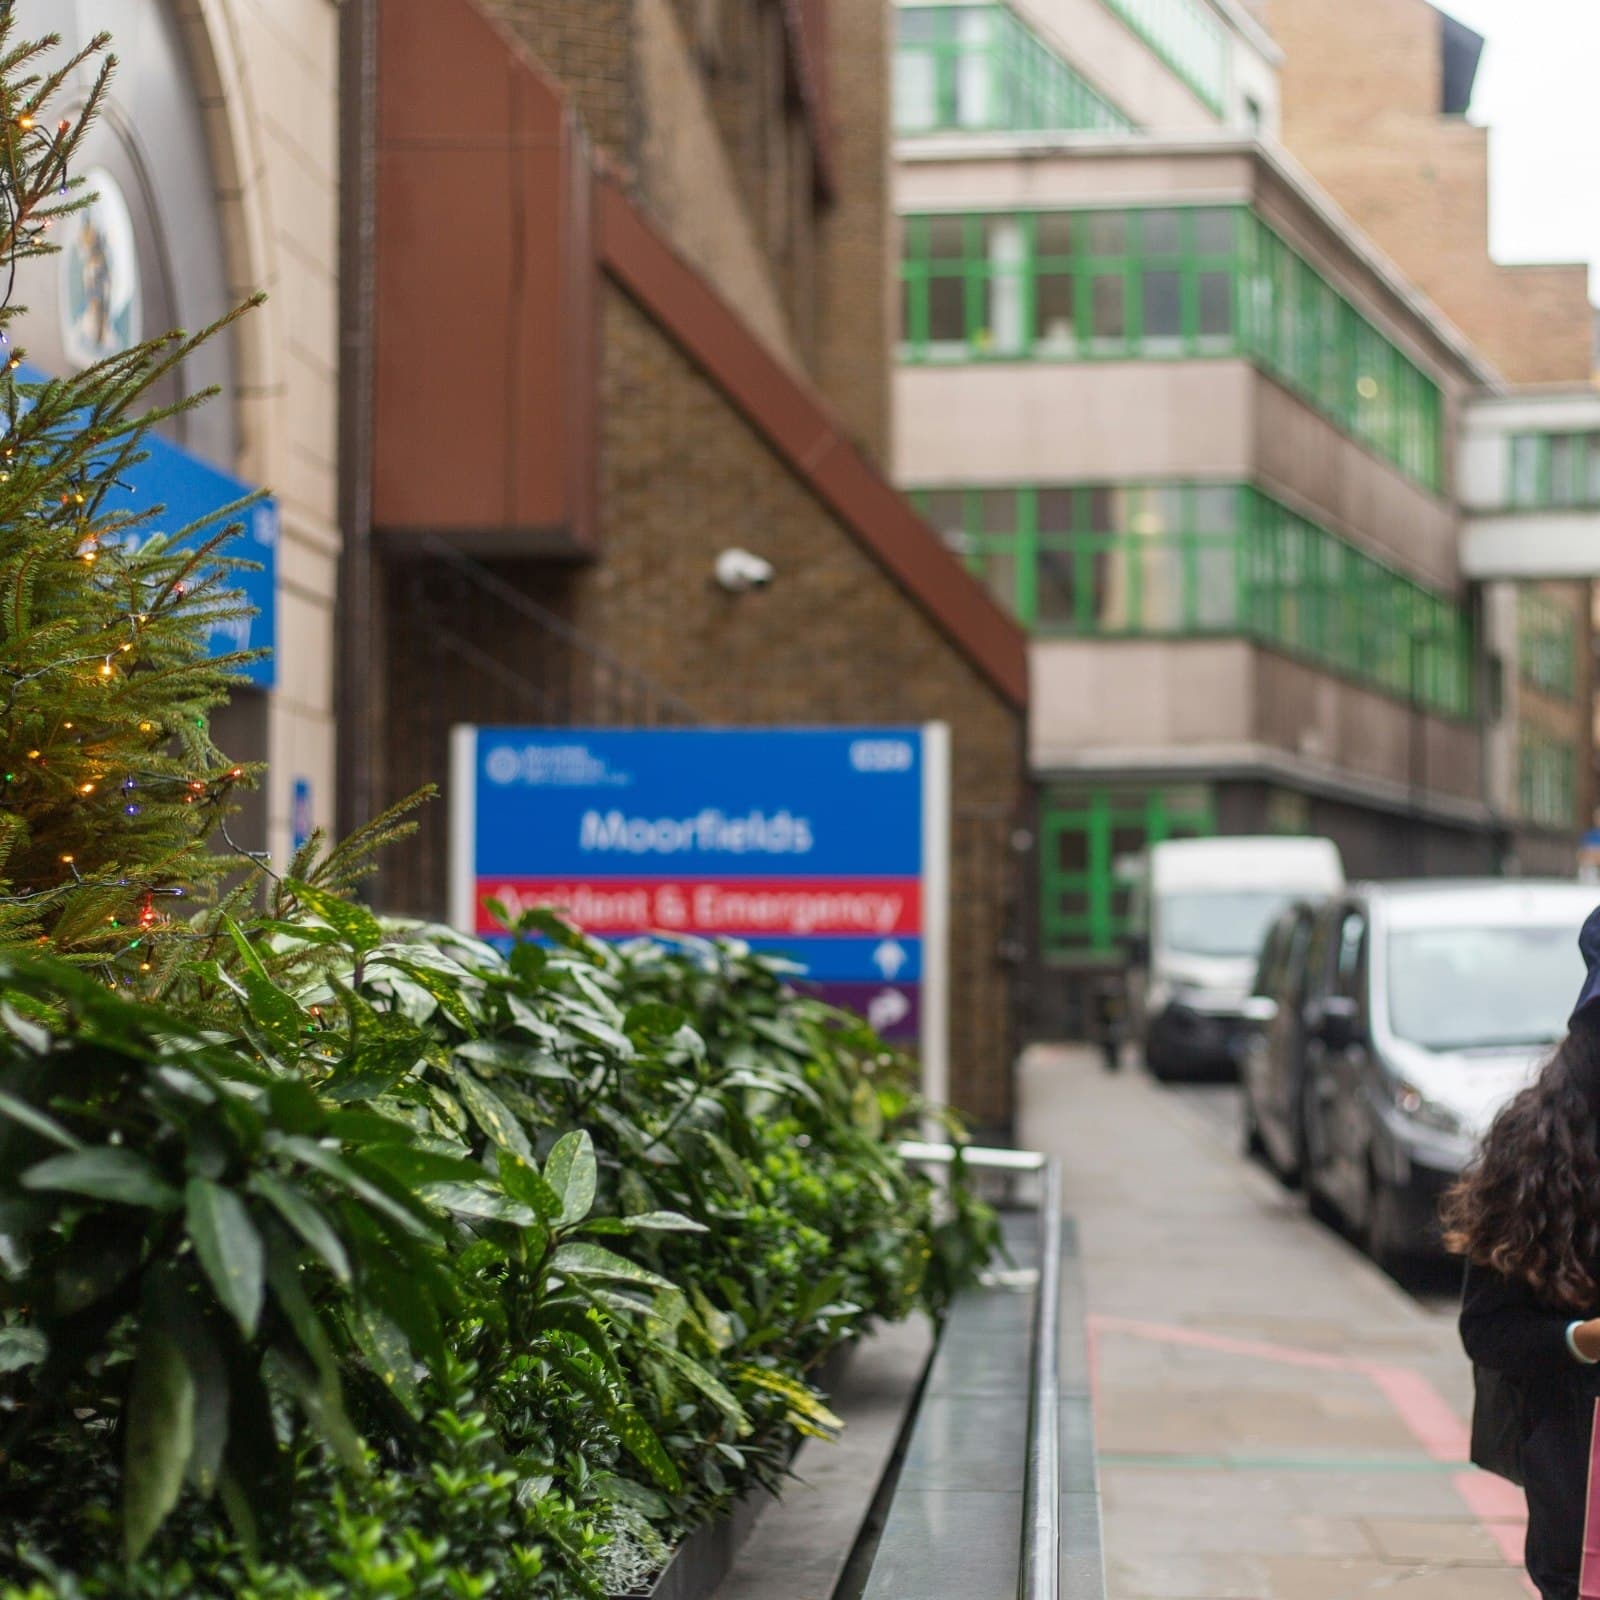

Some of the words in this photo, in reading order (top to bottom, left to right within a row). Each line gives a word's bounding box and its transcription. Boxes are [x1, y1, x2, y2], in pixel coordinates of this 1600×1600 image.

[581, 809, 812, 853] Moorfields
[655, 885, 687, 928] &
[693, 885, 902, 935] Emergency
